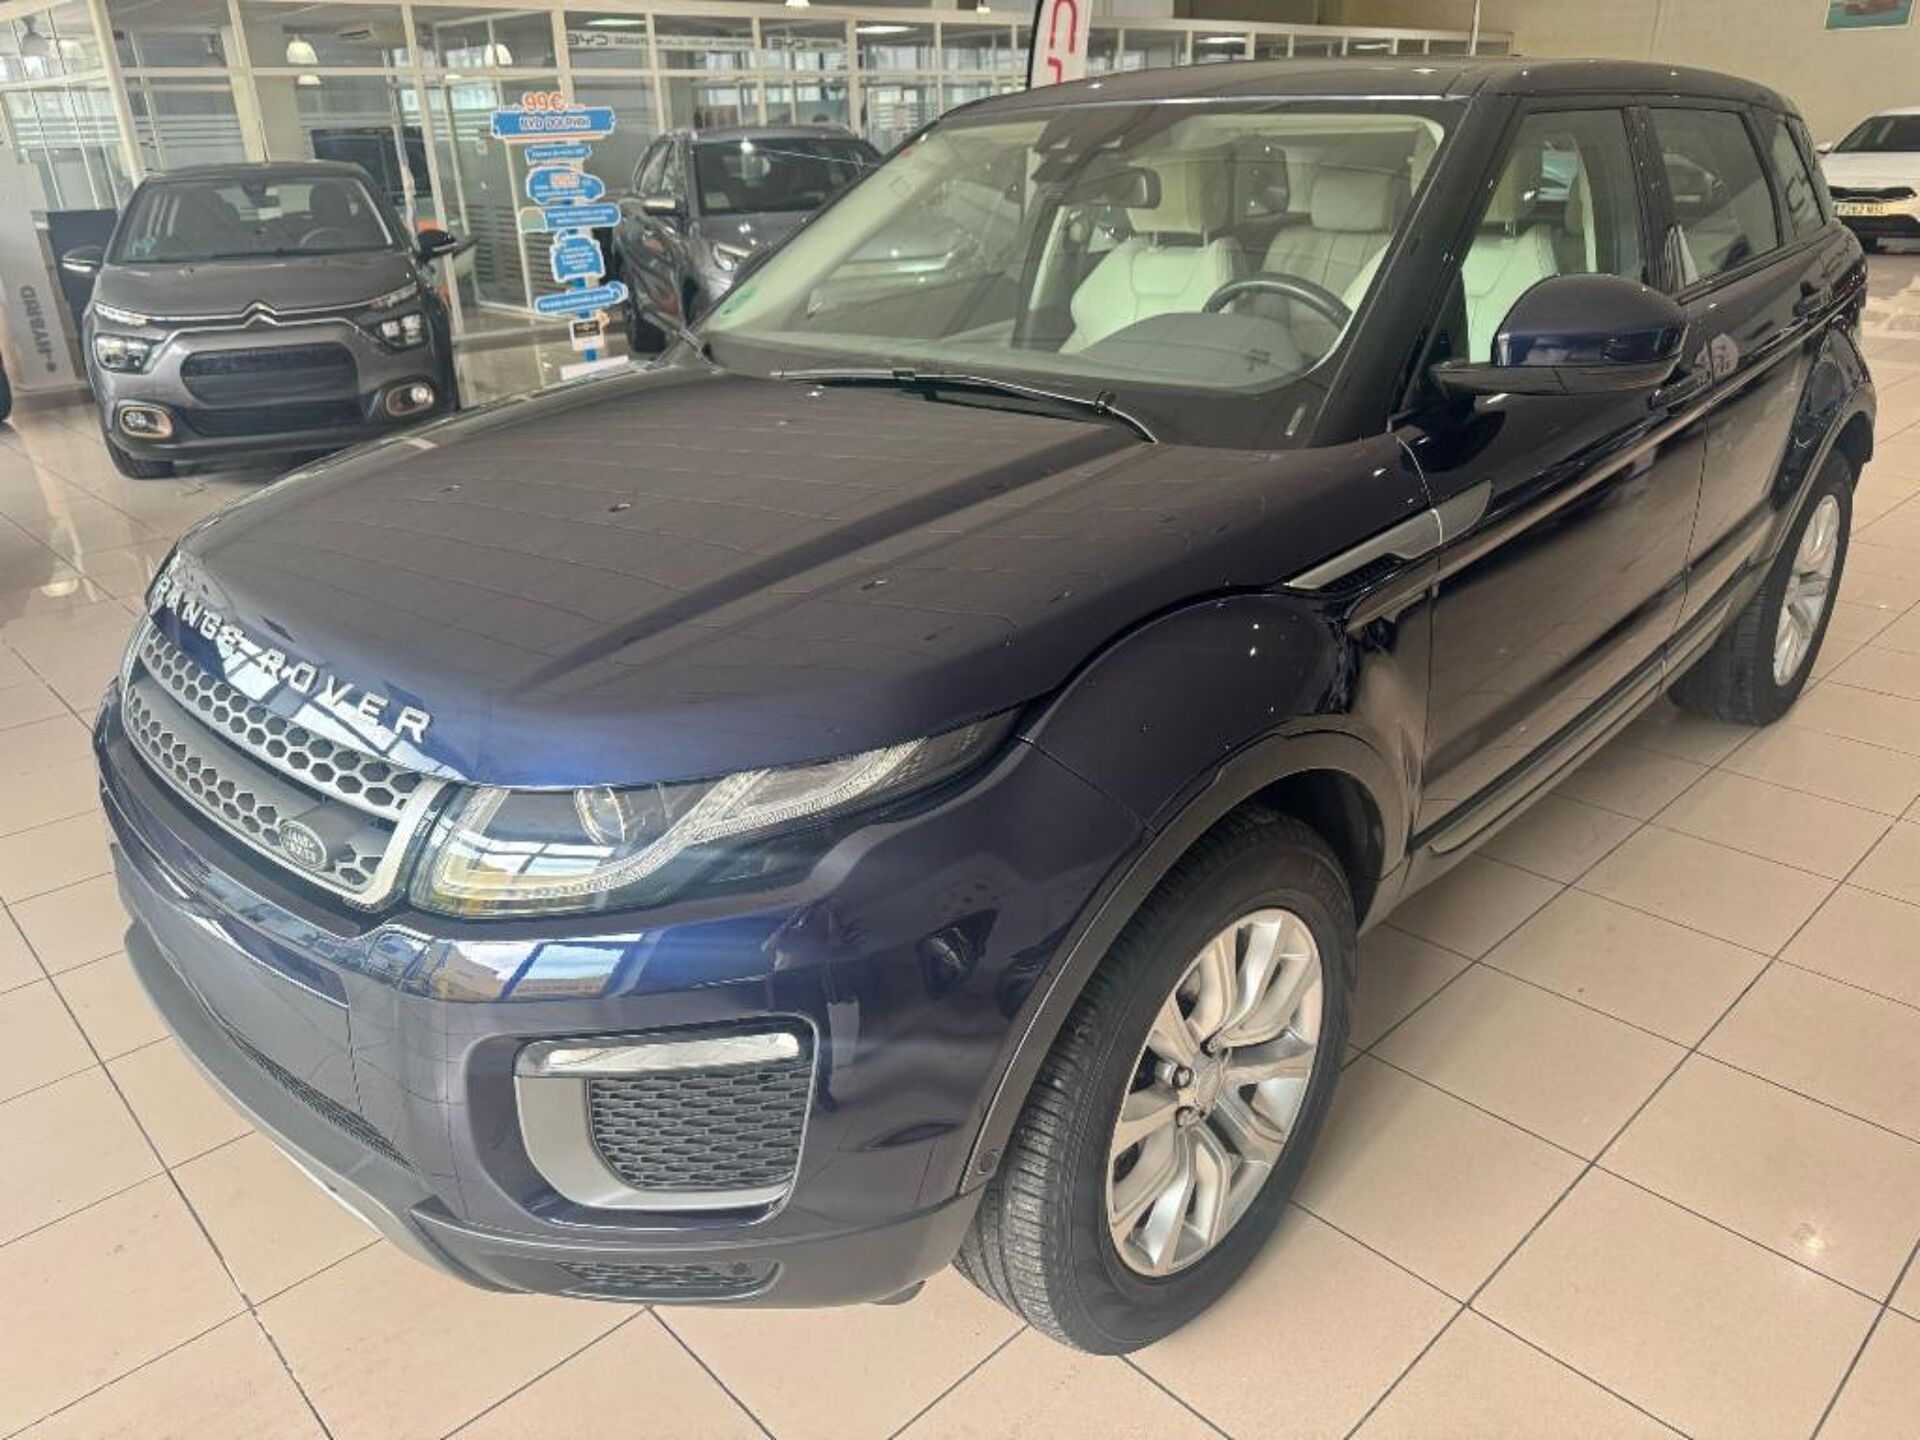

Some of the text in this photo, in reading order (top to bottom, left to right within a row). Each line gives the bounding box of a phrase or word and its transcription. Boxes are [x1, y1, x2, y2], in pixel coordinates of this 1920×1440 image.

[523, 92, 564, 110] 99€
[154, 572, 433, 744] RANGE ROVER
